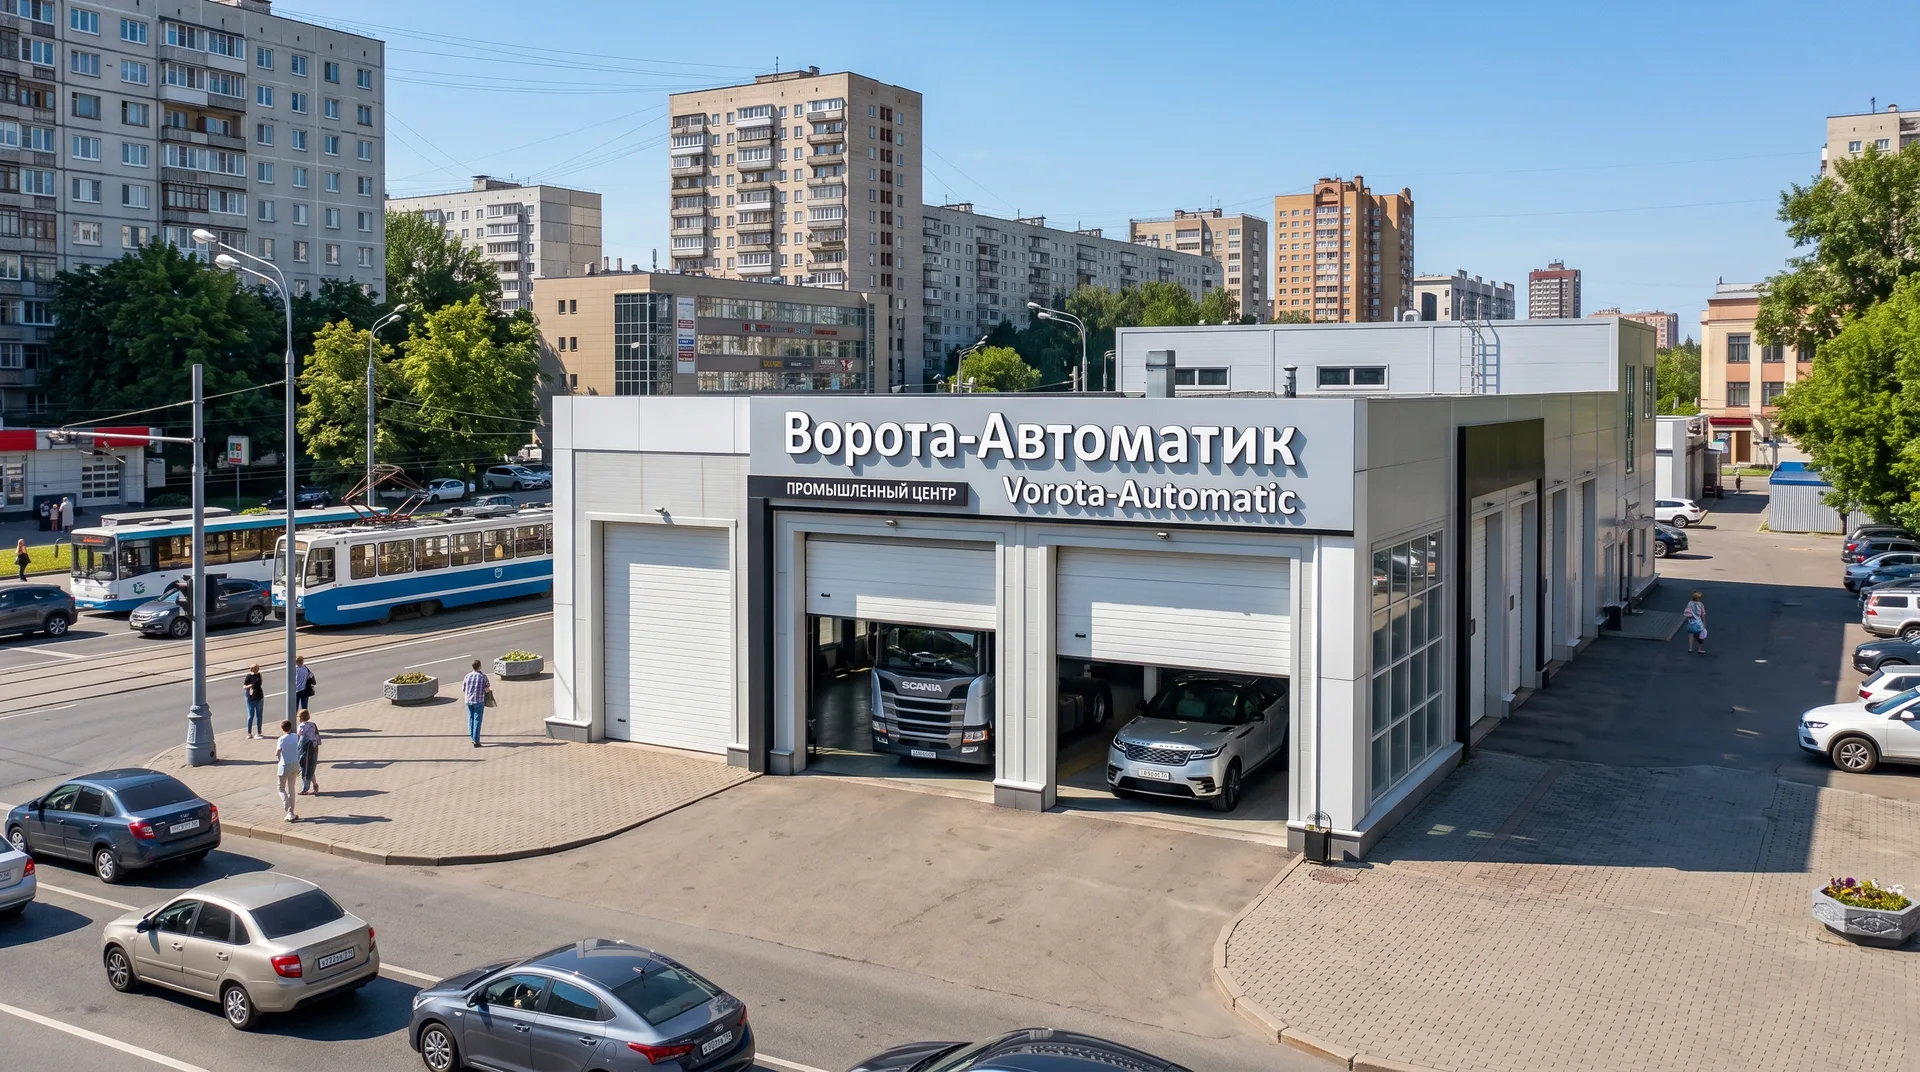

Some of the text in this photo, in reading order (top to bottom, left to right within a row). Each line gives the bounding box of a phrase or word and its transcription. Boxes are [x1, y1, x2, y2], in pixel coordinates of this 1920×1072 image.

[785, 410, 1297, 467] Ворота-Автоматик
[787, 482, 957, 501] ПРОМЫШЛЕННЫЙ ЦЕНТР
[1002, 475, 1297, 515] Vorota-Automatic
[901, 681, 942, 692] SCANIA
